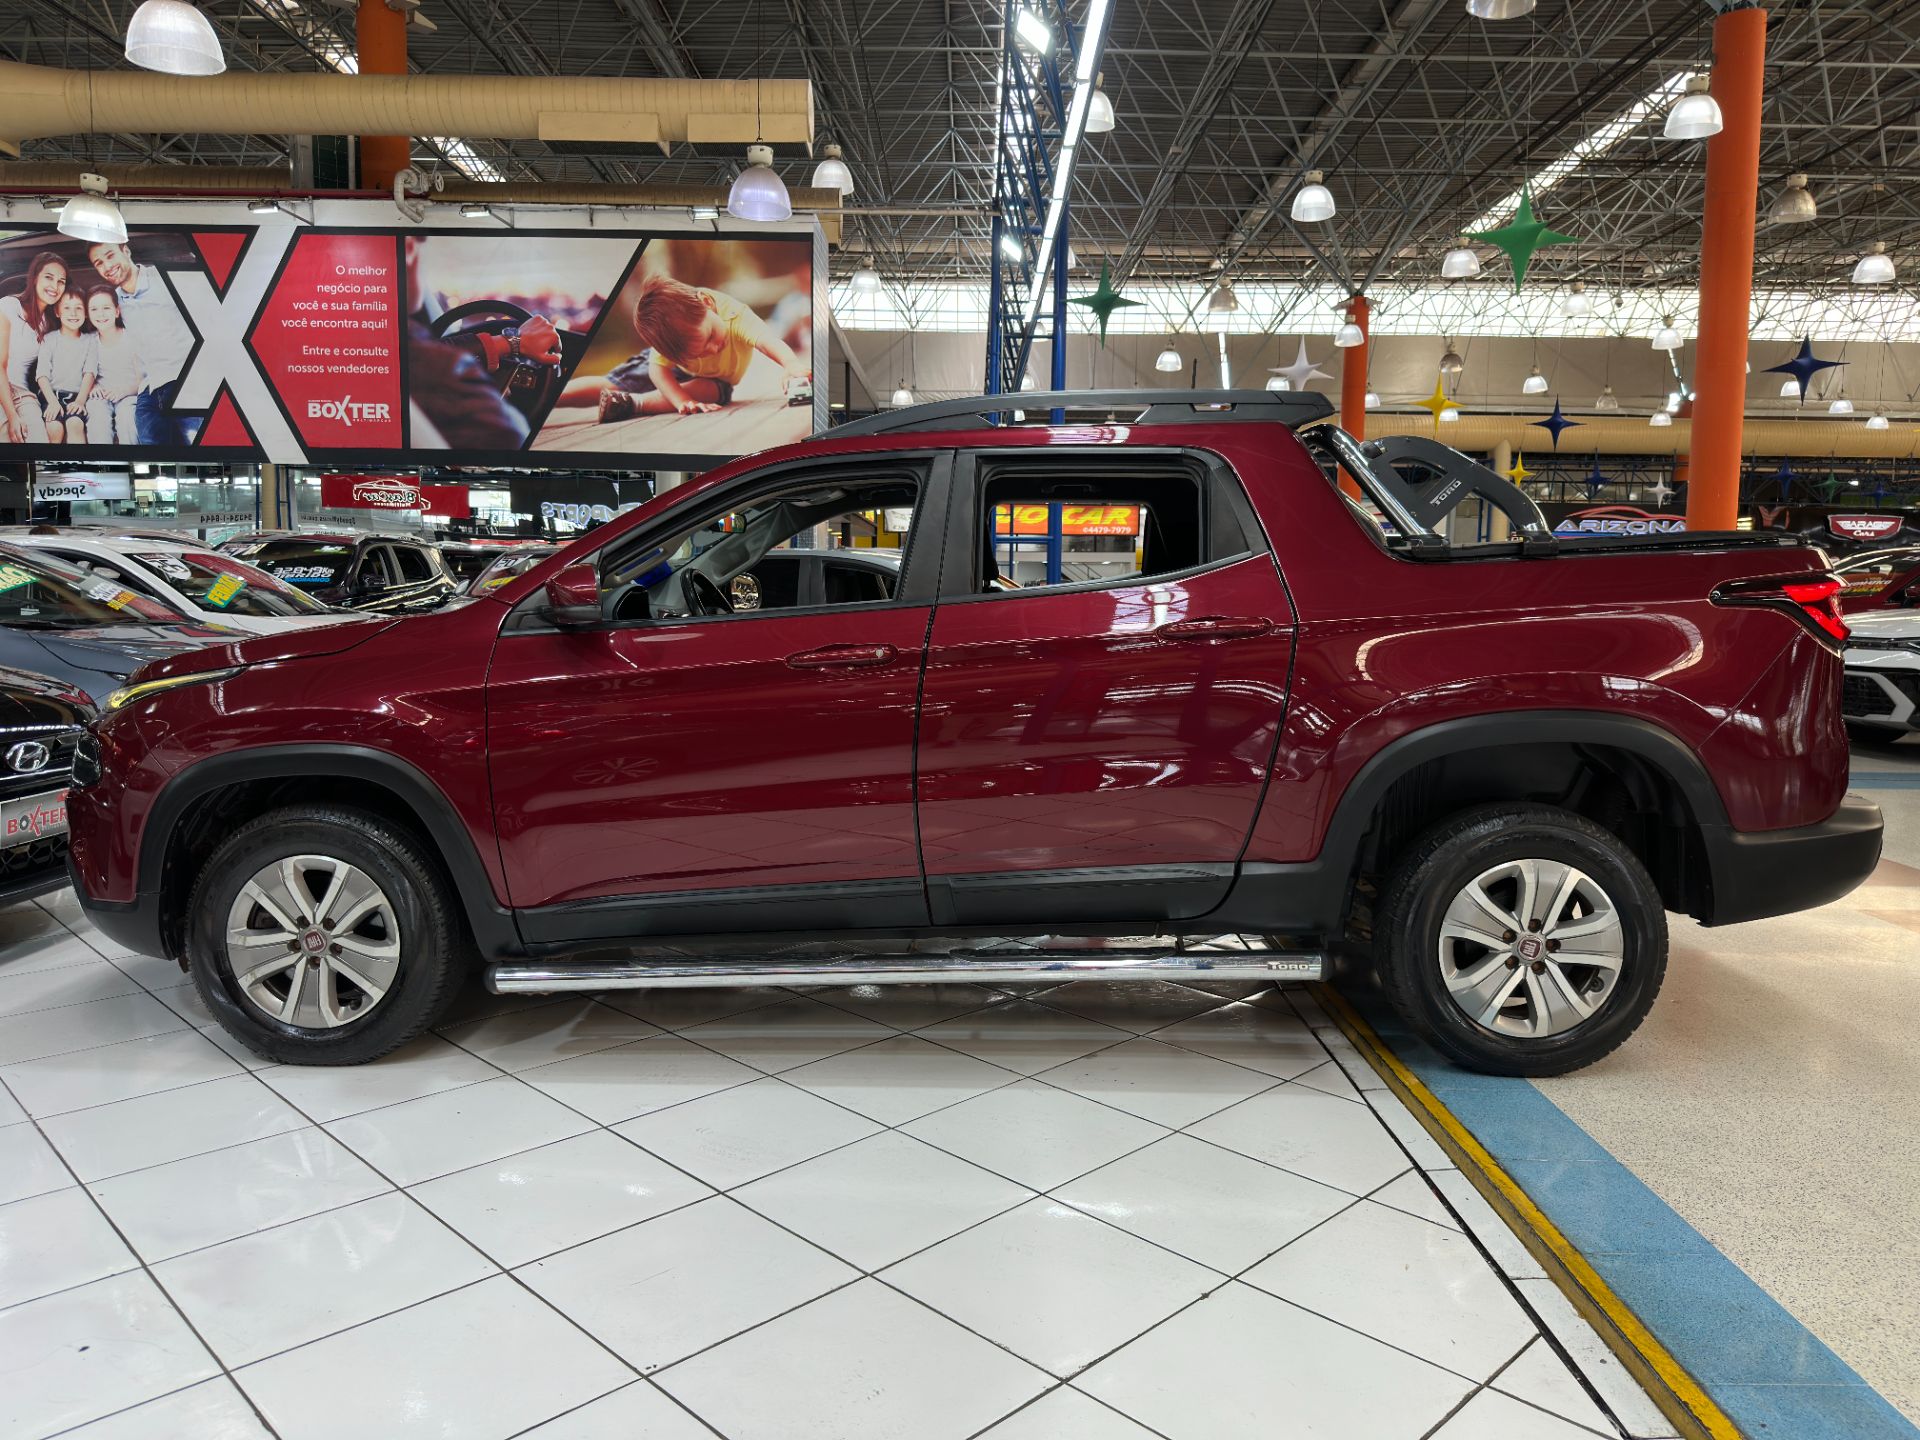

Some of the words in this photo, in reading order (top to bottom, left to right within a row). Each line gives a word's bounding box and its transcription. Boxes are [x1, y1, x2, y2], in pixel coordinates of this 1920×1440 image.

[336, 265, 346, 275] O
[348, 266, 387, 276] melhor
[317, 283, 361, 295] negócio
[364, 285, 387, 295] para
[292, 300, 319, 310] você
[330, 303, 349, 311] sua
[352, 301, 387, 311] família
[281, 317, 308, 328] você
[310, 319, 359, 329] encontra
[361, 319, 388, 331] aqui!
[302, 345, 331, 356] Entre
[333, 348, 340, 356] e
[342, 347, 389, 356] consulte
[287, 365, 325, 373] nossos
[327, 364, 390, 374] vendedores
[308, 395, 391, 427] BOXTER
[1430, 478, 1461, 507] TORO
[1062, 507, 1132, 525] CAR
[7, 804, 67, 837] BOXTER
[1267, 961, 1310, 970] TORO
